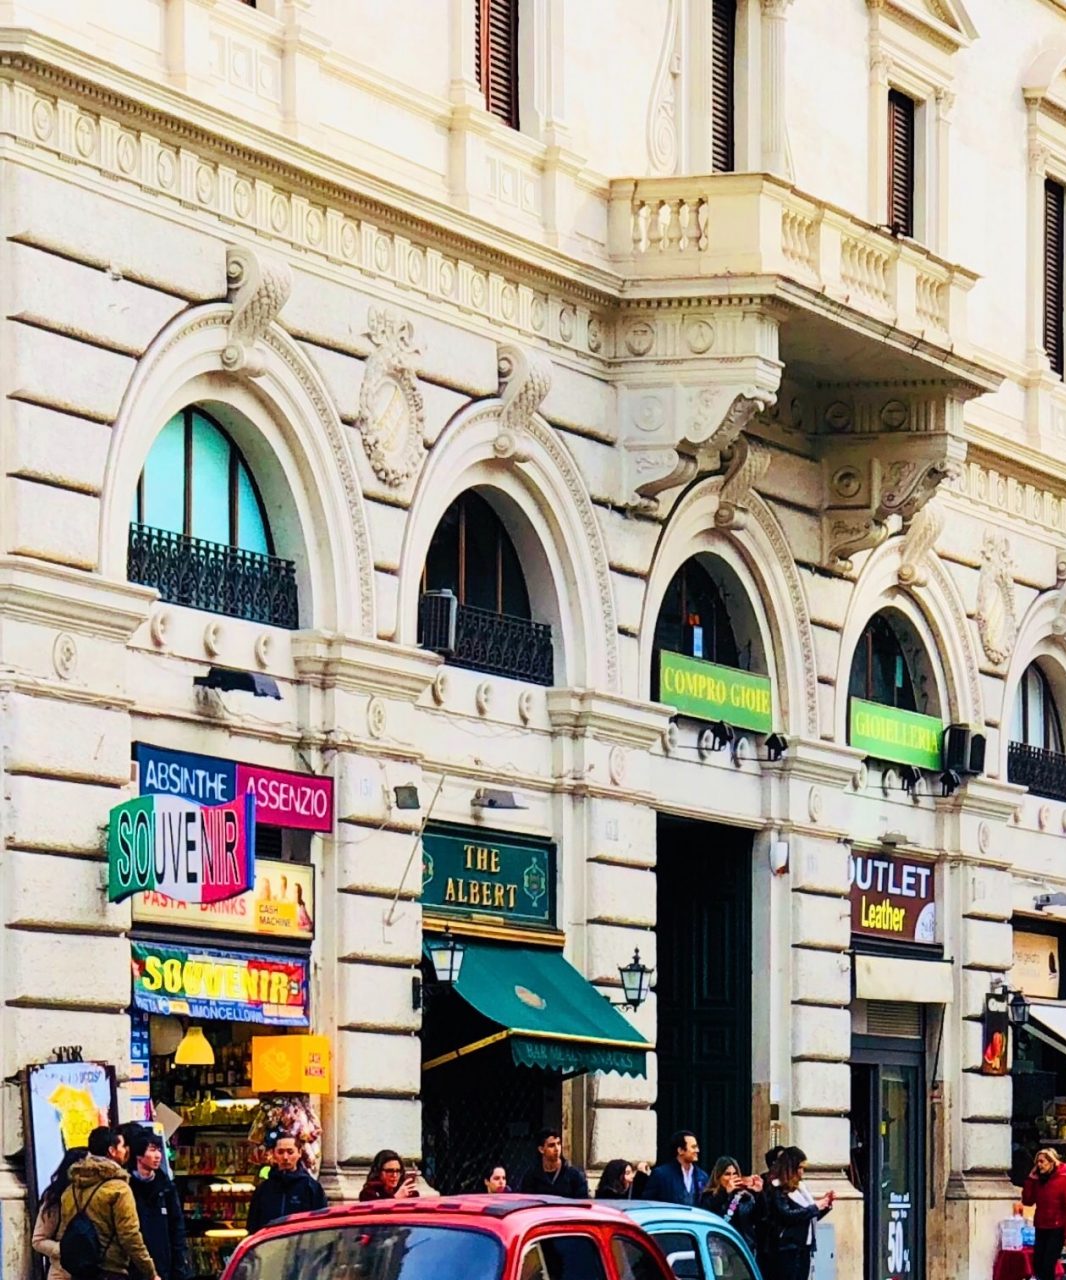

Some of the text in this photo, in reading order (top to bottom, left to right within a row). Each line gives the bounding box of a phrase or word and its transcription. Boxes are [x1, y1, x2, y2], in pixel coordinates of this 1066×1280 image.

[663, 666, 771, 715] COMPRO GIOIE
[145, 759, 228, 802] ABSINTHE
[246, 776, 328, 819] ASSENZIO
[117, 808, 242, 888] SOUVENIR
[463, 844, 501, 873] THE
[258, 904, 279, 915] CASH
[445, 877, 518, 909] ALBERT
[258, 916, 293, 928] MACHINE
[861, 895, 906, 932] Leather
